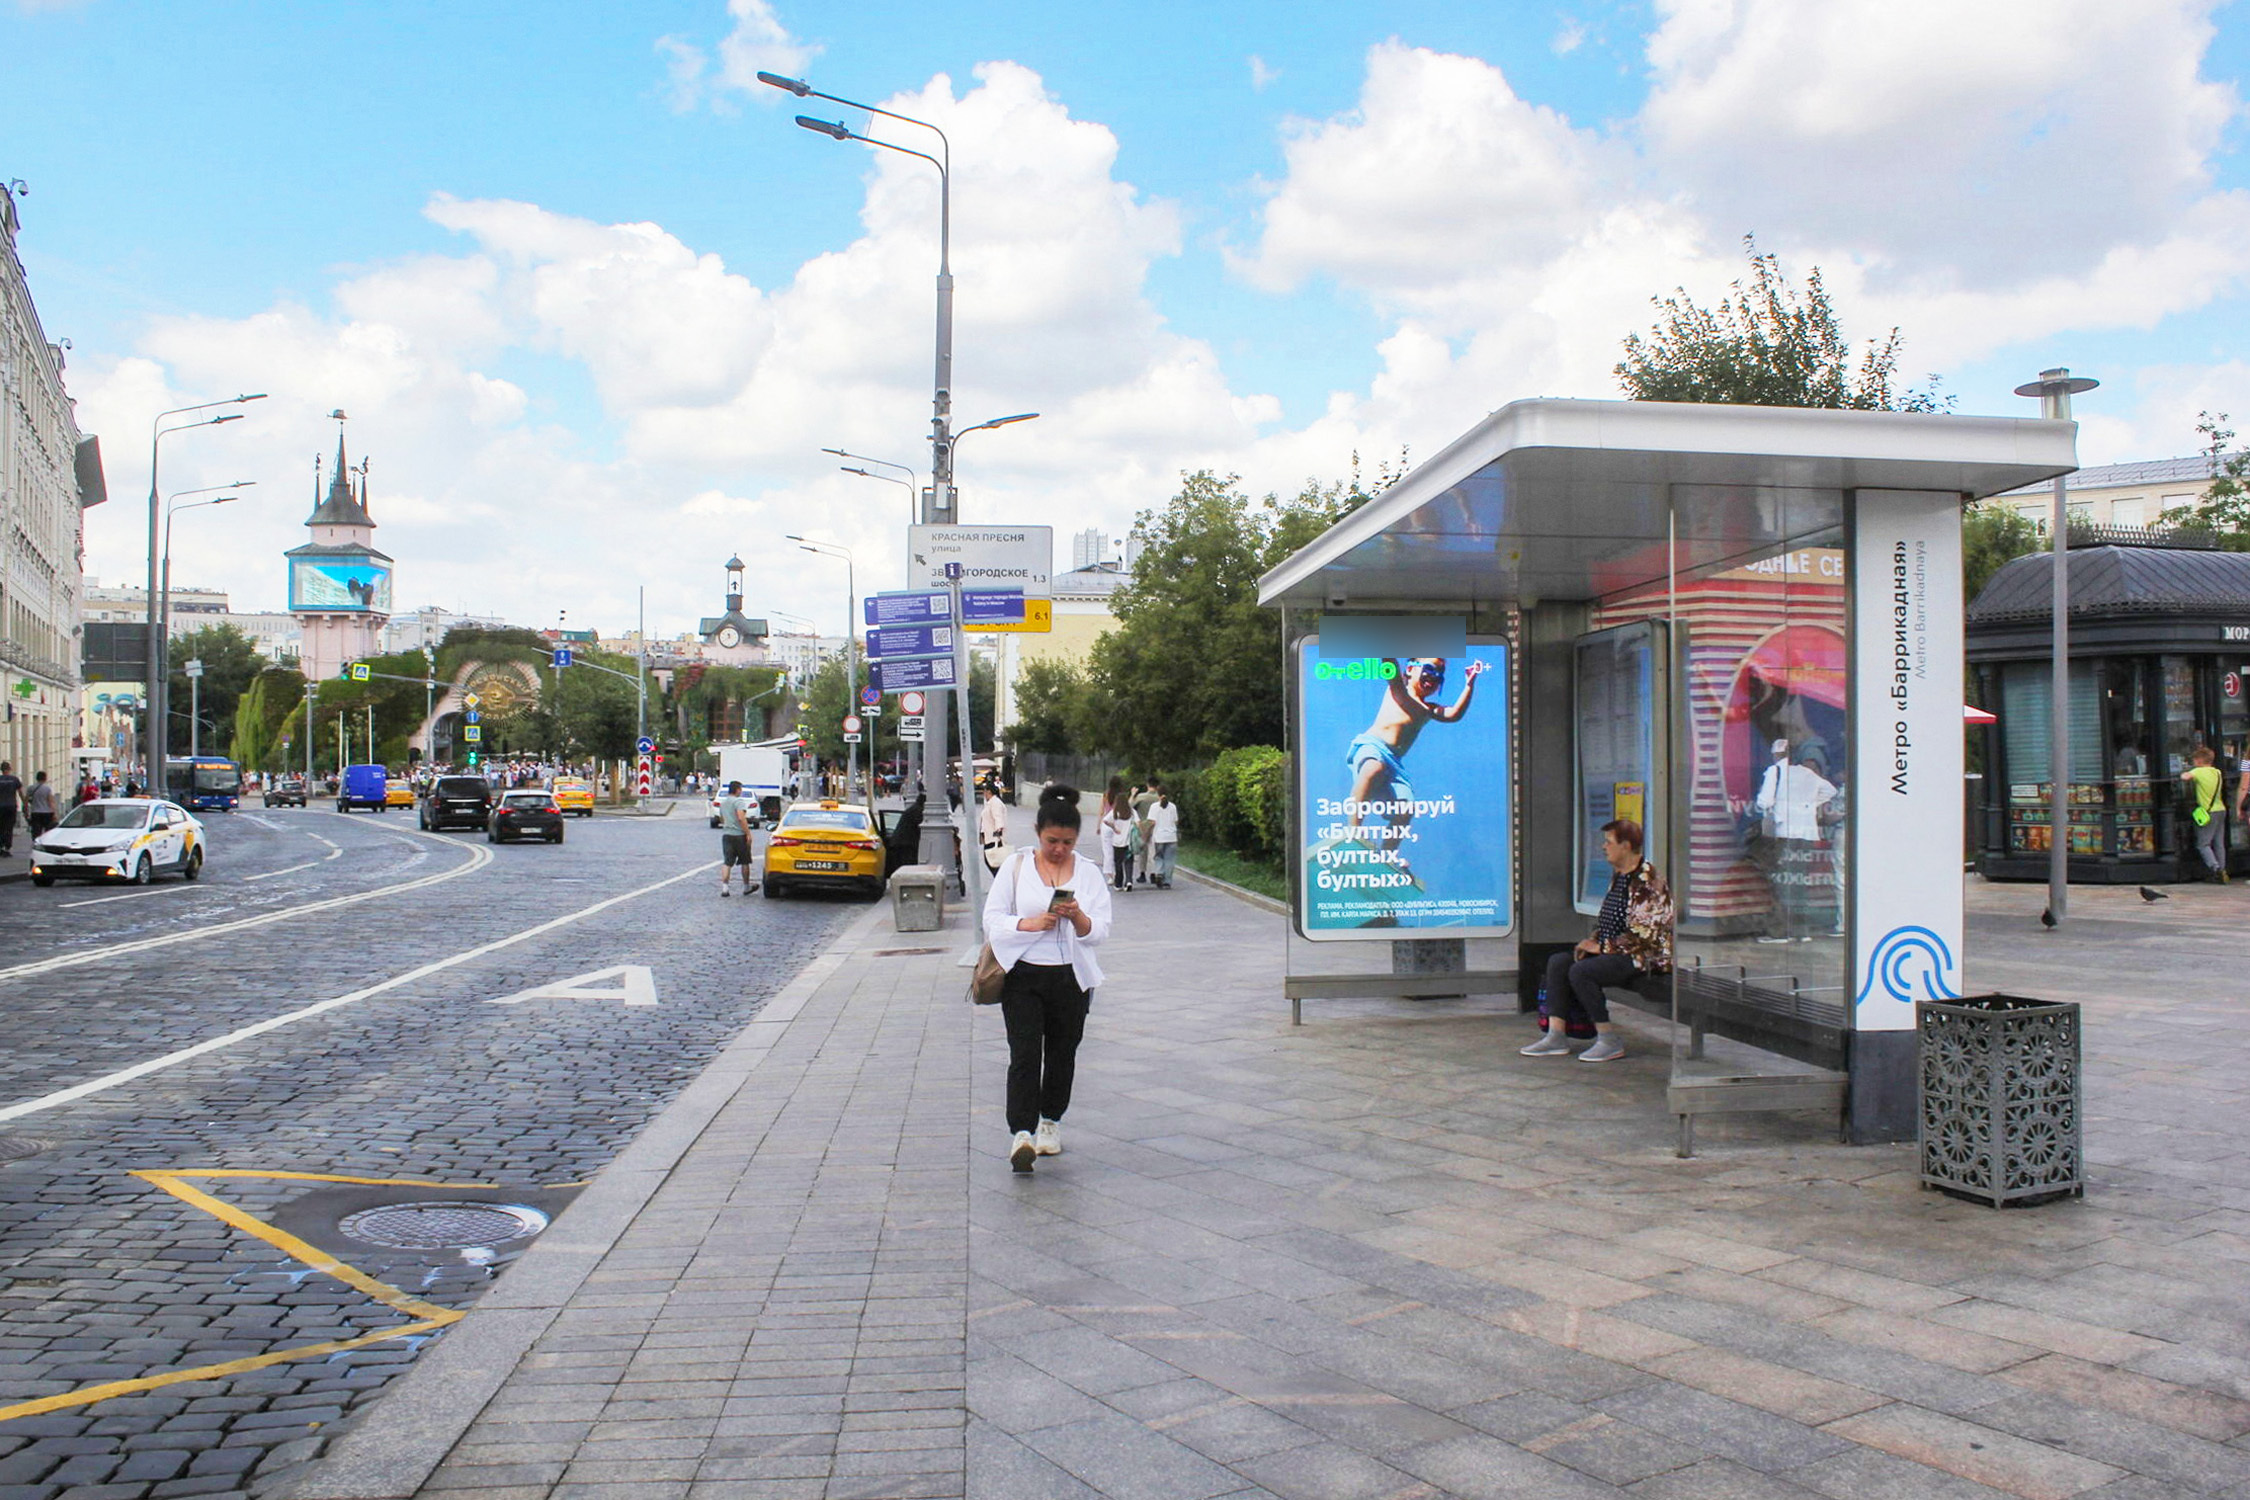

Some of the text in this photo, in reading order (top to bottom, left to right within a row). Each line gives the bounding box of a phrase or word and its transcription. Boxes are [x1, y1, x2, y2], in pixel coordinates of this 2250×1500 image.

[931, 533, 1025, 542] КРАСНАЯ ПРЕСНЯ
[931, 545, 961, 554] улица
[931, 568, 1028, 578] ЗВГОРОДСКОЕ
[1034, 612, 1048, 620] 6.1
[1914, 541, 1928, 679] Metro Barrikadnaya
[1891, 541, 1911, 795] Метро «Баррикадная»
[1317, 795, 1455, 818] Забронируй
[1317, 822, 1418, 843] «Бултых,
[1317, 846, 1408, 867] бултых,
[1317, 870, 1413, 892] бултых»
